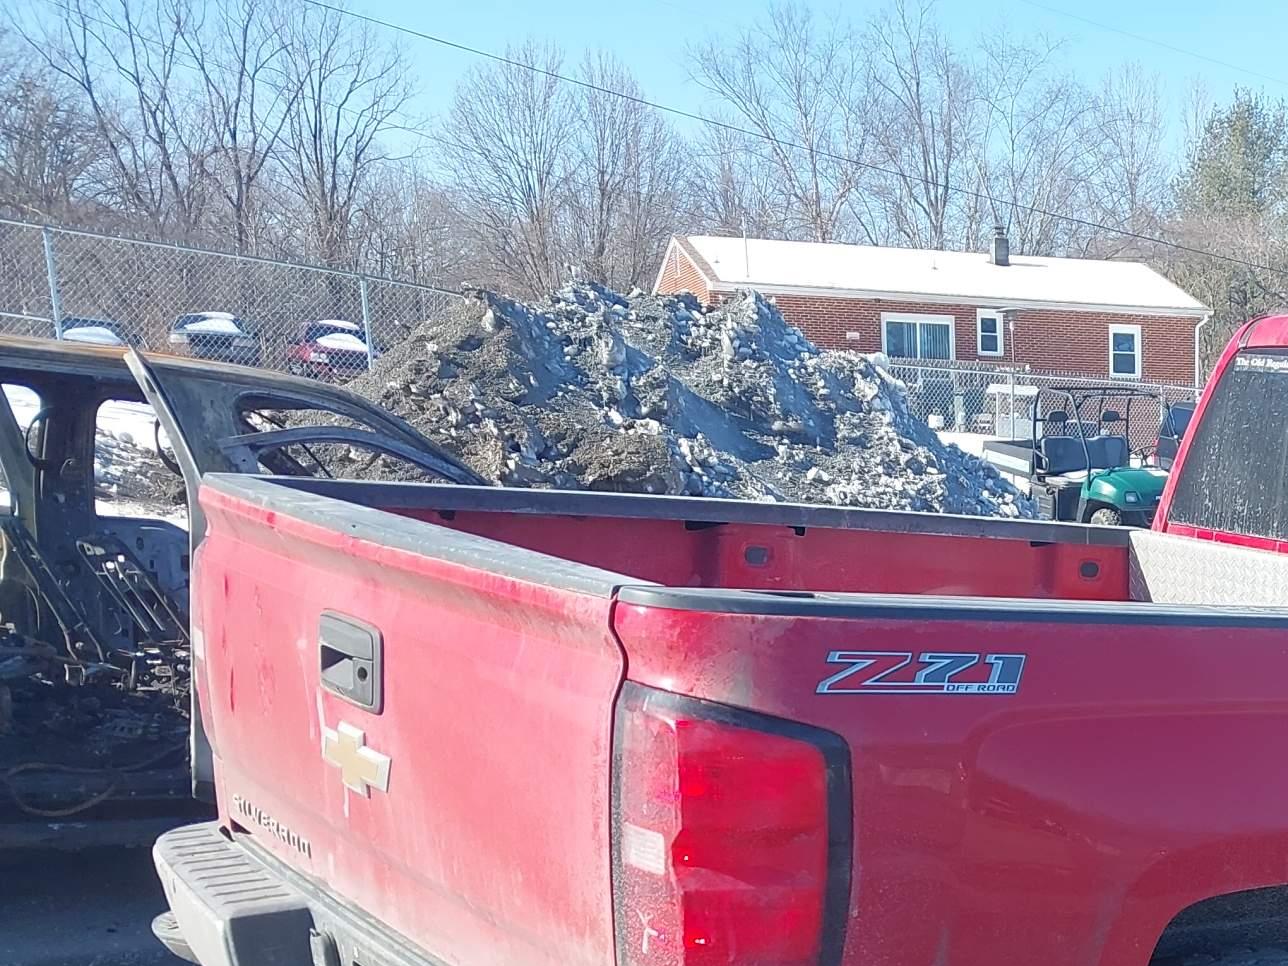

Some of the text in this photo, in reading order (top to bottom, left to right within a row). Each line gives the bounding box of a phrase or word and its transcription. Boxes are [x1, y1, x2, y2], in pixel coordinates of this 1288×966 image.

[1235, 357, 1249, 366] The
[1250, 358, 1266, 367] Old
[815, 650, 1026, 694] Z71
[946, 684, 1016, 692] OFF ROAD
